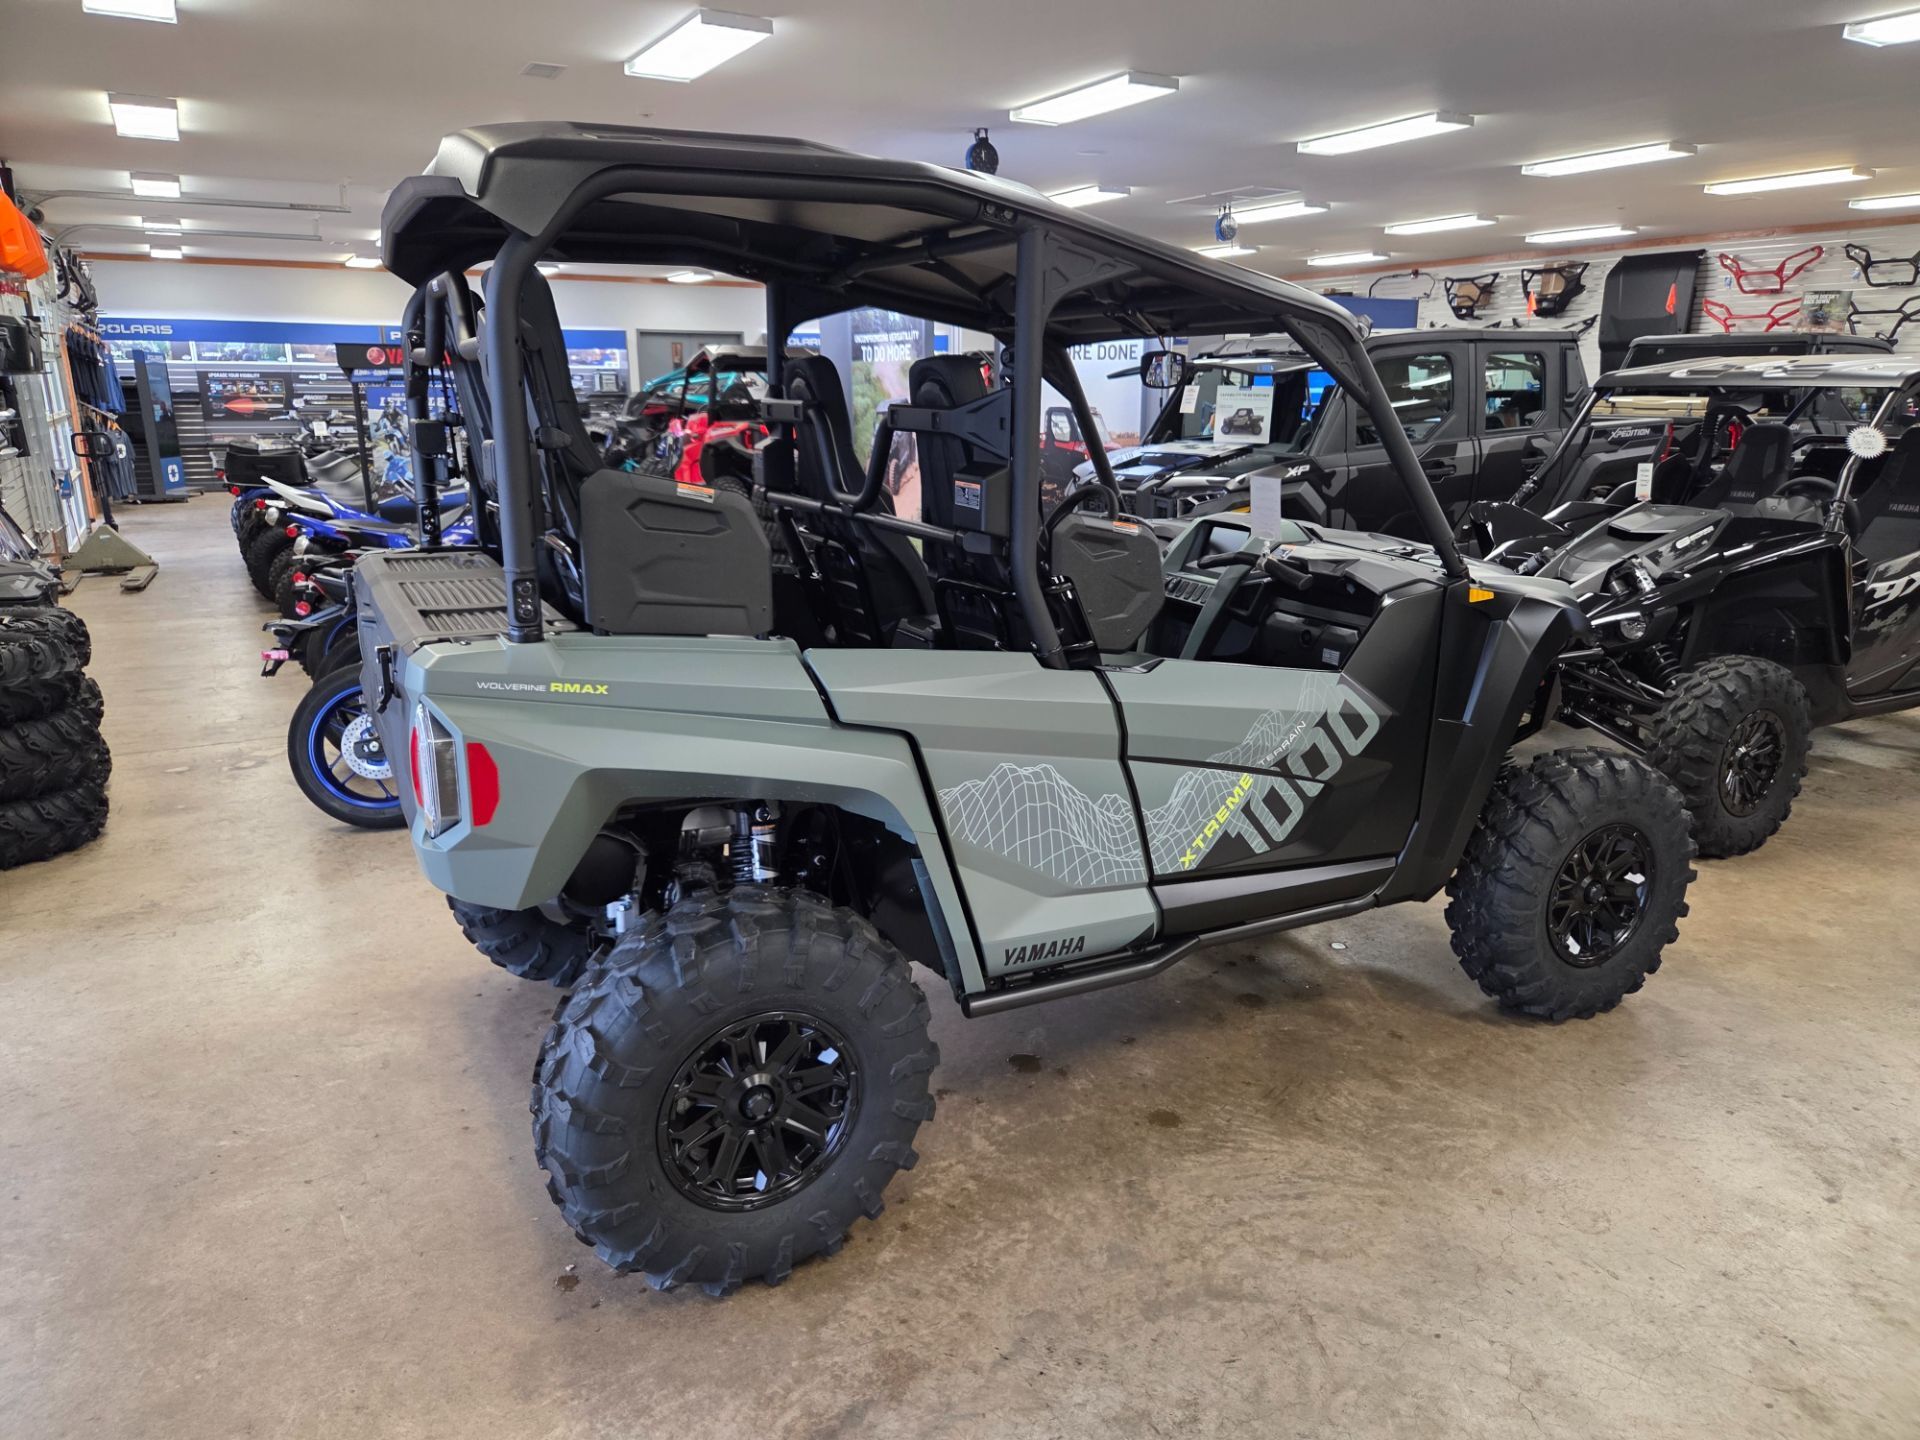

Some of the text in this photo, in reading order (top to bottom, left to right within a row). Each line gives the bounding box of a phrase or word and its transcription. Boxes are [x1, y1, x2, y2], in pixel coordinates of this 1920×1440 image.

[97, 323, 173, 335] POLARIS
[861, 343, 911, 362] TO DO MORE
[1097, 344, 1139, 360] DONE
[1284, 464, 1310, 477] XP
[1730, 490, 1755, 499] YAMAHA
[1889, 503, 1920, 513] YAMAHA
[477, 681, 609, 695] WOLVERINE RMAX
[1224, 683, 1380, 854] 1000
[1179, 720, 1306, 869] XTREME TERRAIN
[1003, 935, 1086, 967] YAMAHA
